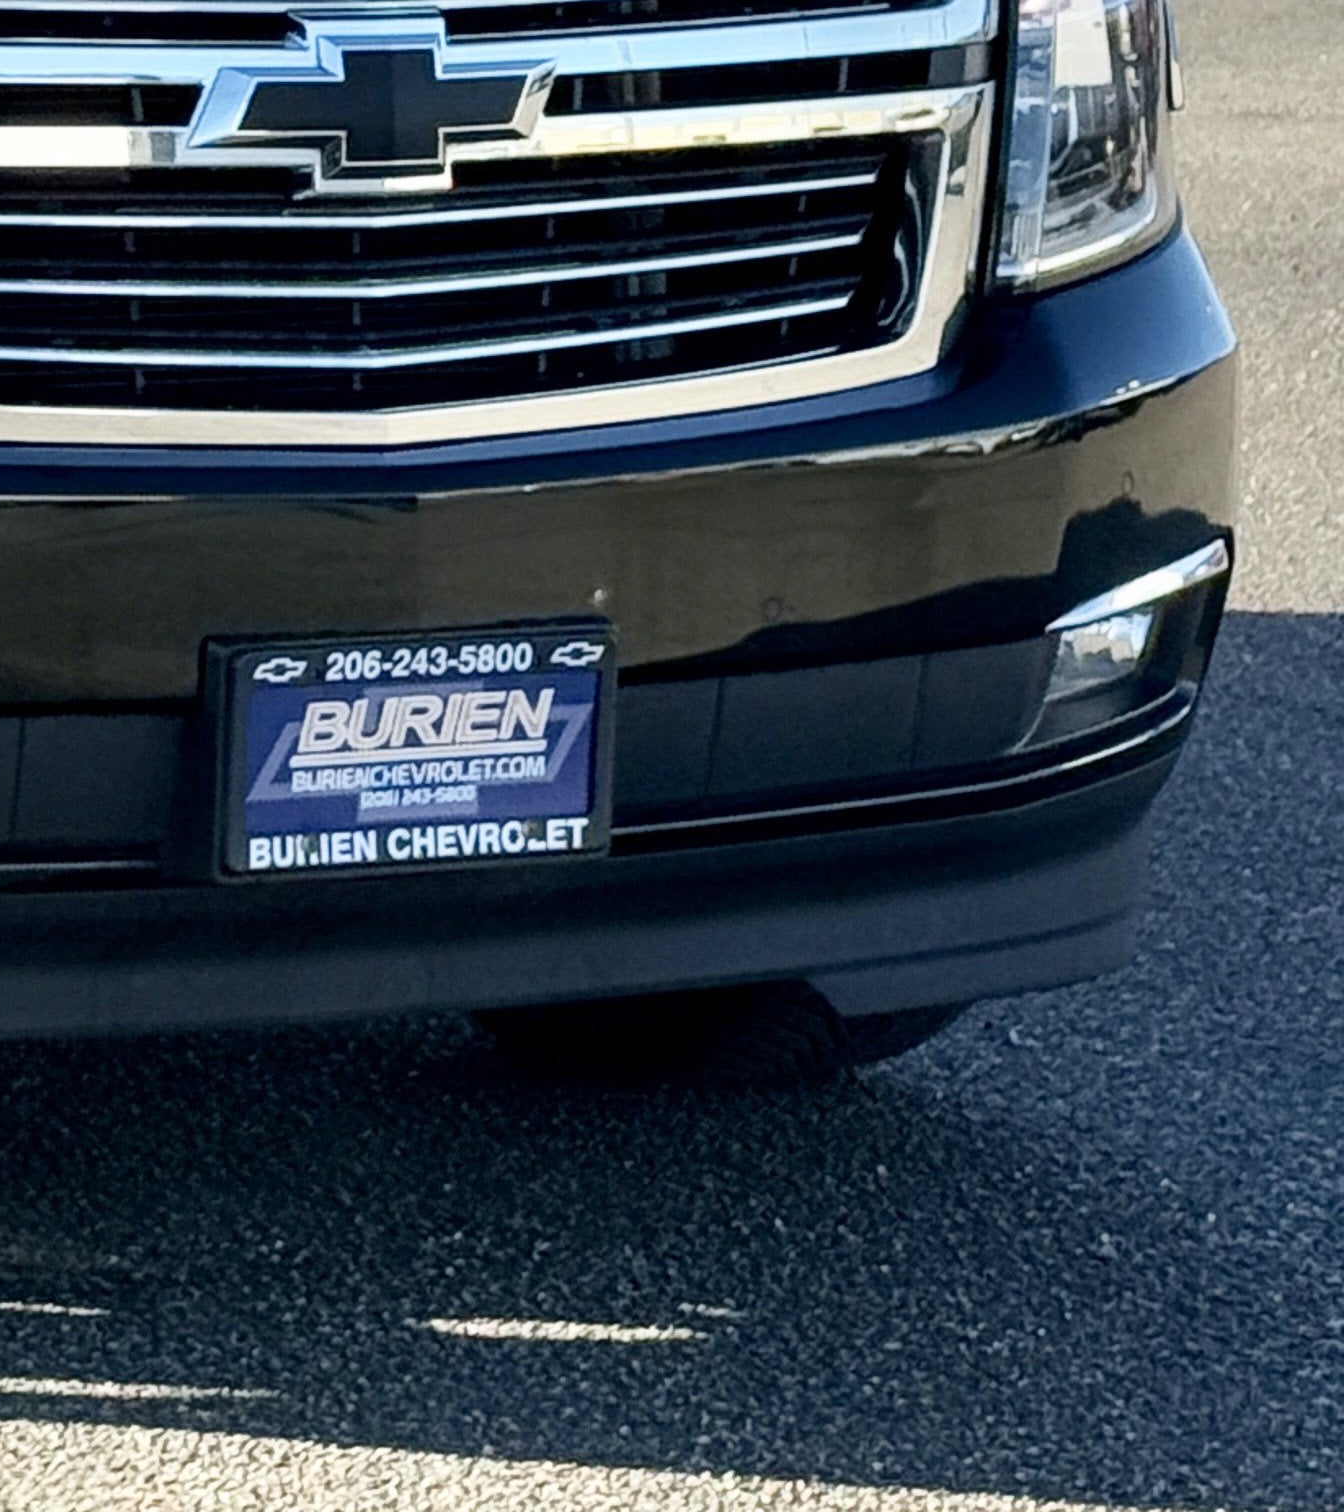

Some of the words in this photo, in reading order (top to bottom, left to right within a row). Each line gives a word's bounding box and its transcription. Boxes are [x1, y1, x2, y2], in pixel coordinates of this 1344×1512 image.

[325, 642, 534, 682] 206-243-5800
[297, 688, 555, 754] BURIEN
[291, 755, 547, 793] BURIENCHEVROLET.COM
